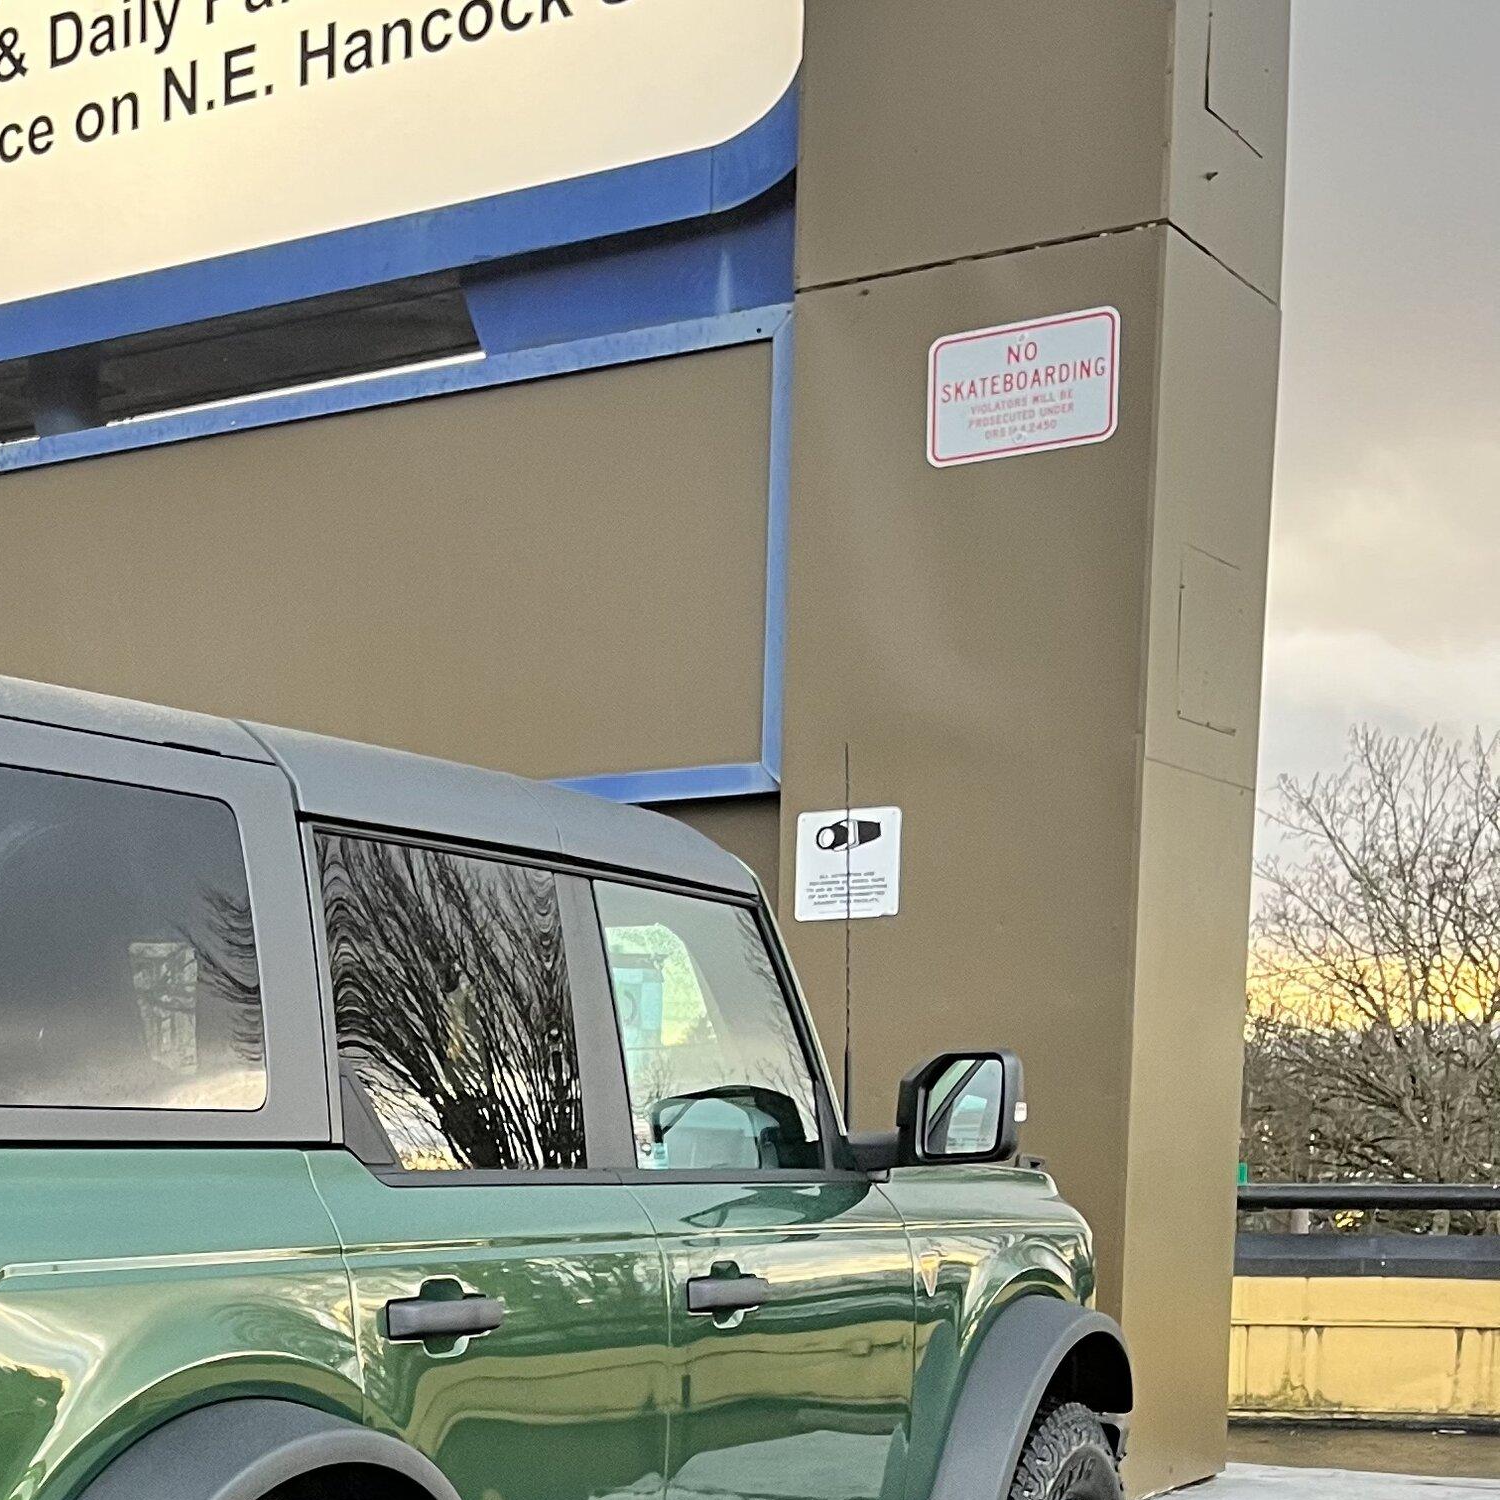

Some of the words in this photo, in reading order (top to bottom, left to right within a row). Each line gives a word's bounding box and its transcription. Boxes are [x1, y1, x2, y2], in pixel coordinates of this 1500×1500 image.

[49, 0, 181, 69] Daily
[75, 91, 140, 143] on
[163, 43, 274, 122] N.E.
[1006, 340, 1039, 365] NO
[940, 356, 1107, 404] SKATEBOARDING
[967, 408, 1036, 430] PROSECUTED
[1039, 402, 1075, 418] UNDER
[970, 394, 1028, 415] VIOLATORS
